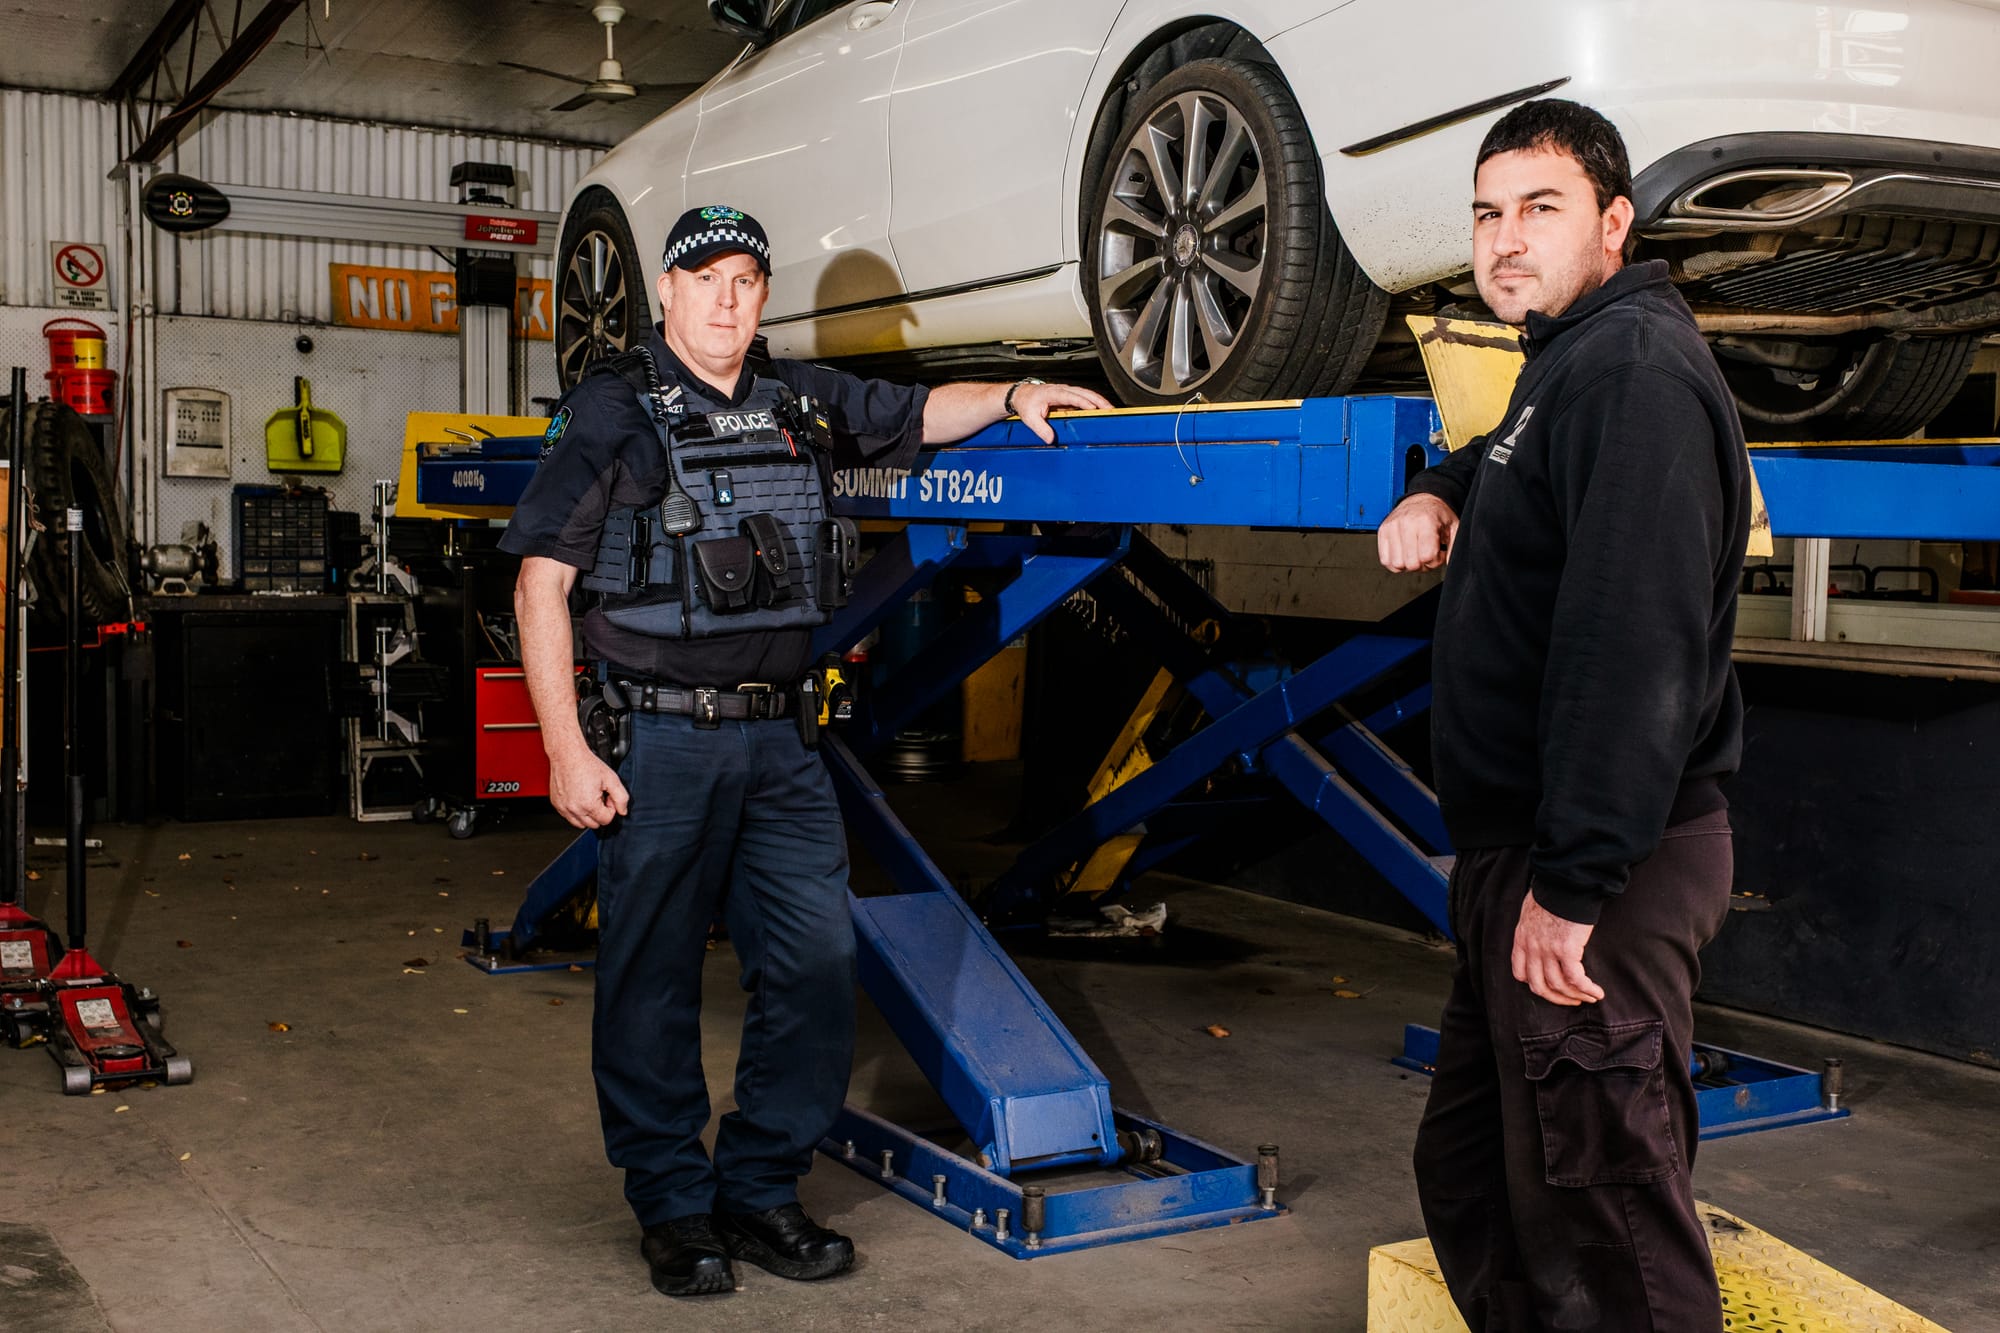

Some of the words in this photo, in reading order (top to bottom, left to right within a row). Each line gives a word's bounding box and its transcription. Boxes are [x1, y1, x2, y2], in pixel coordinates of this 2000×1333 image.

[710, 219, 738, 228] POLICE
[348, 275, 412, 322] NO
[715, 412, 772, 432] POLICE
[832, 467, 912, 499] SUMMIT
